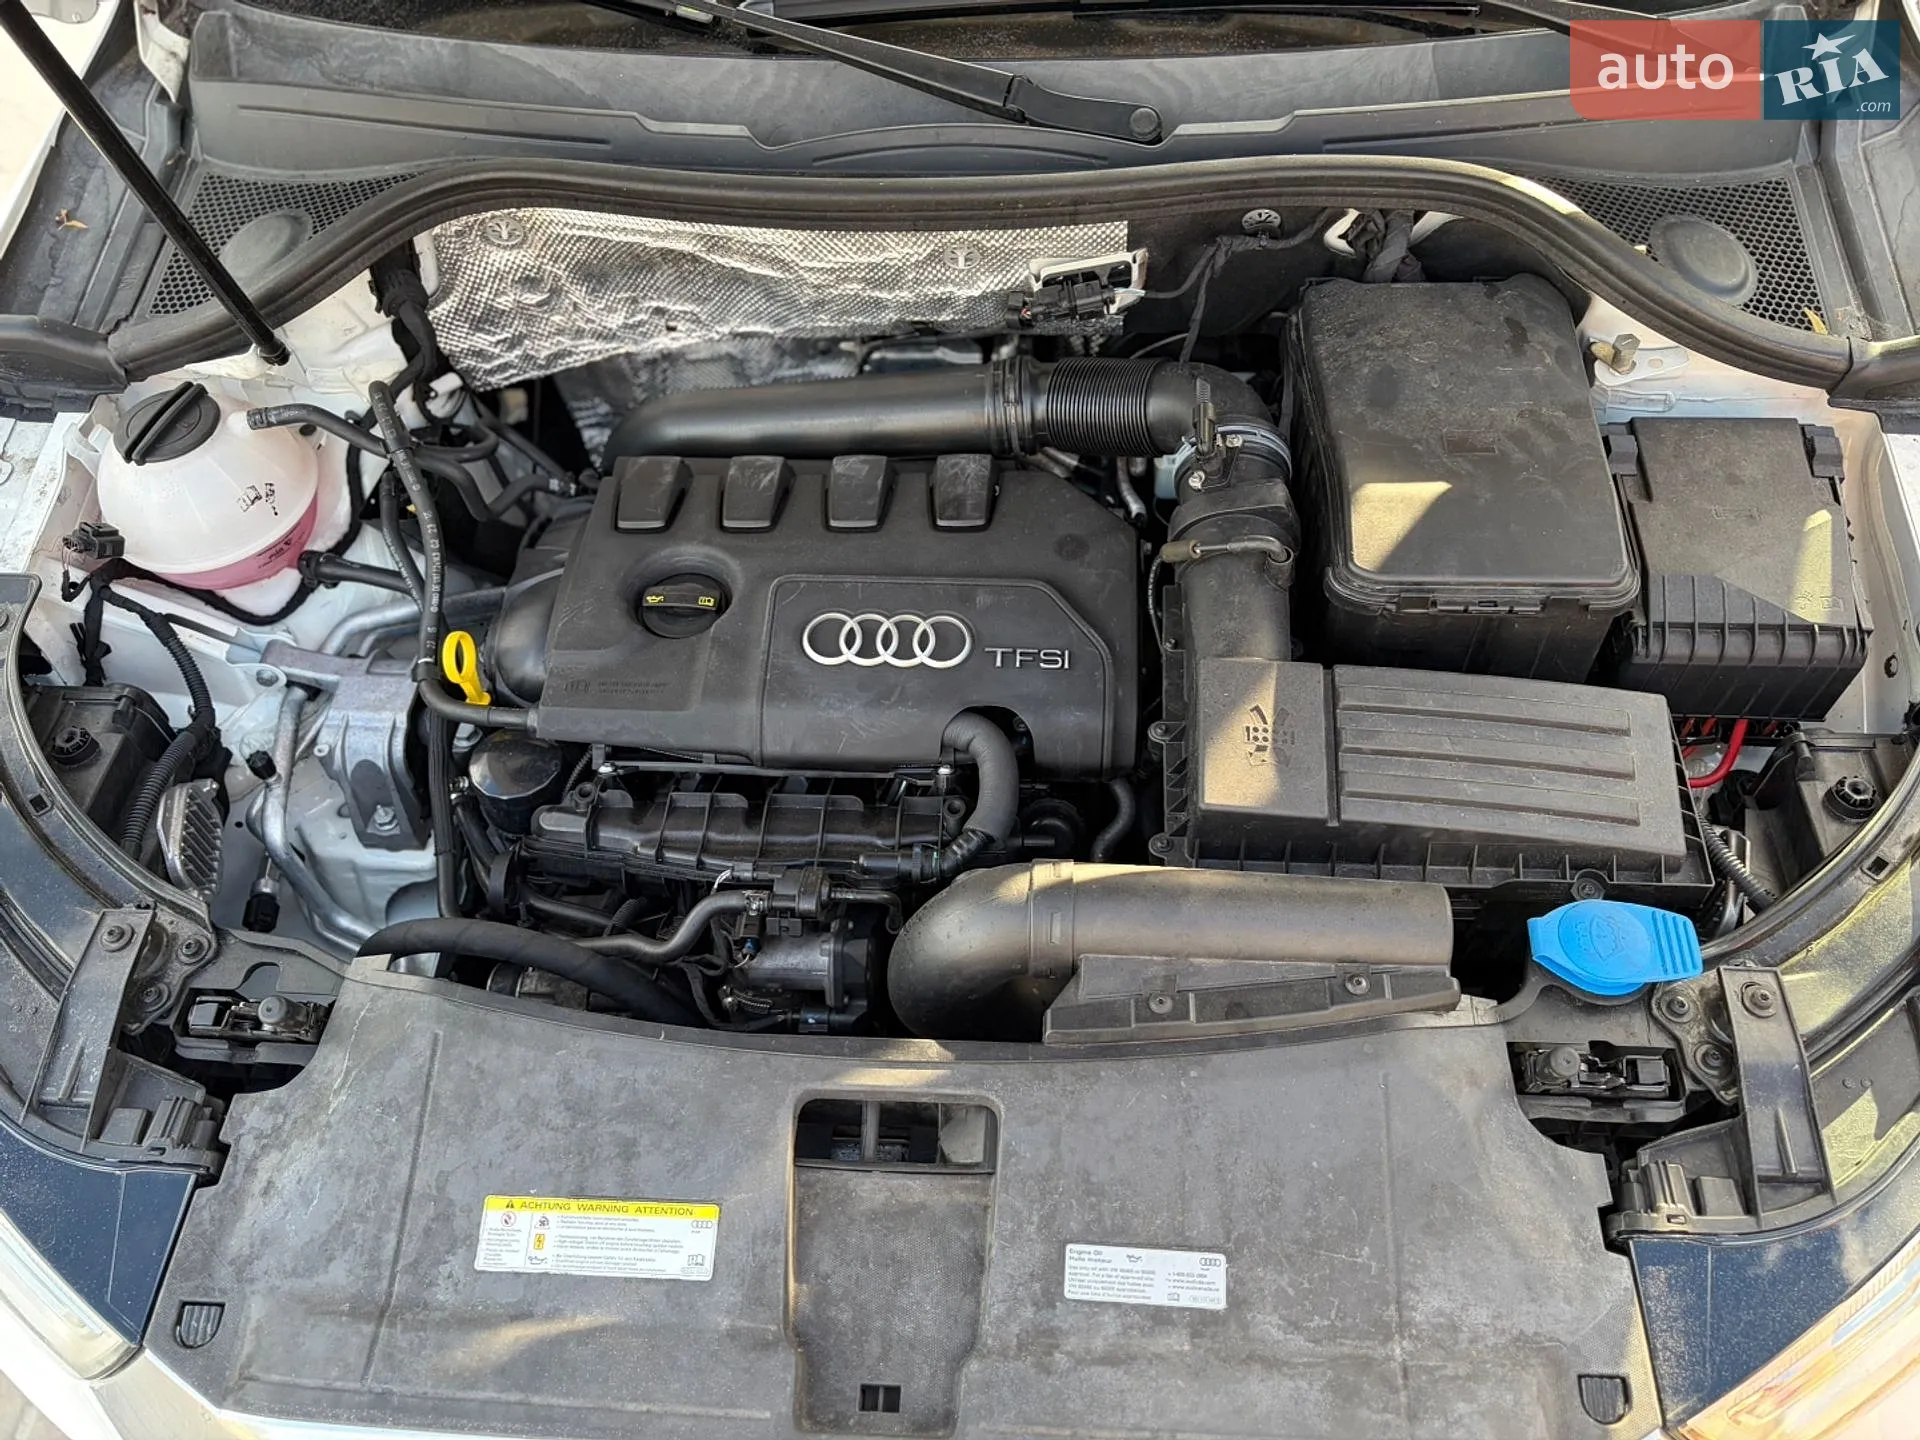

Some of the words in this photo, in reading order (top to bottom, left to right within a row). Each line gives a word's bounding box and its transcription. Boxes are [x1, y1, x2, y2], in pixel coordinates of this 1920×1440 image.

[984, 647, 1070, 670] TFSI
[520, 1200, 571, 1211] ACHTUNG
[577, 1202, 629, 1214] WARNING
[634, 1205, 694, 1217] ATTENTION
